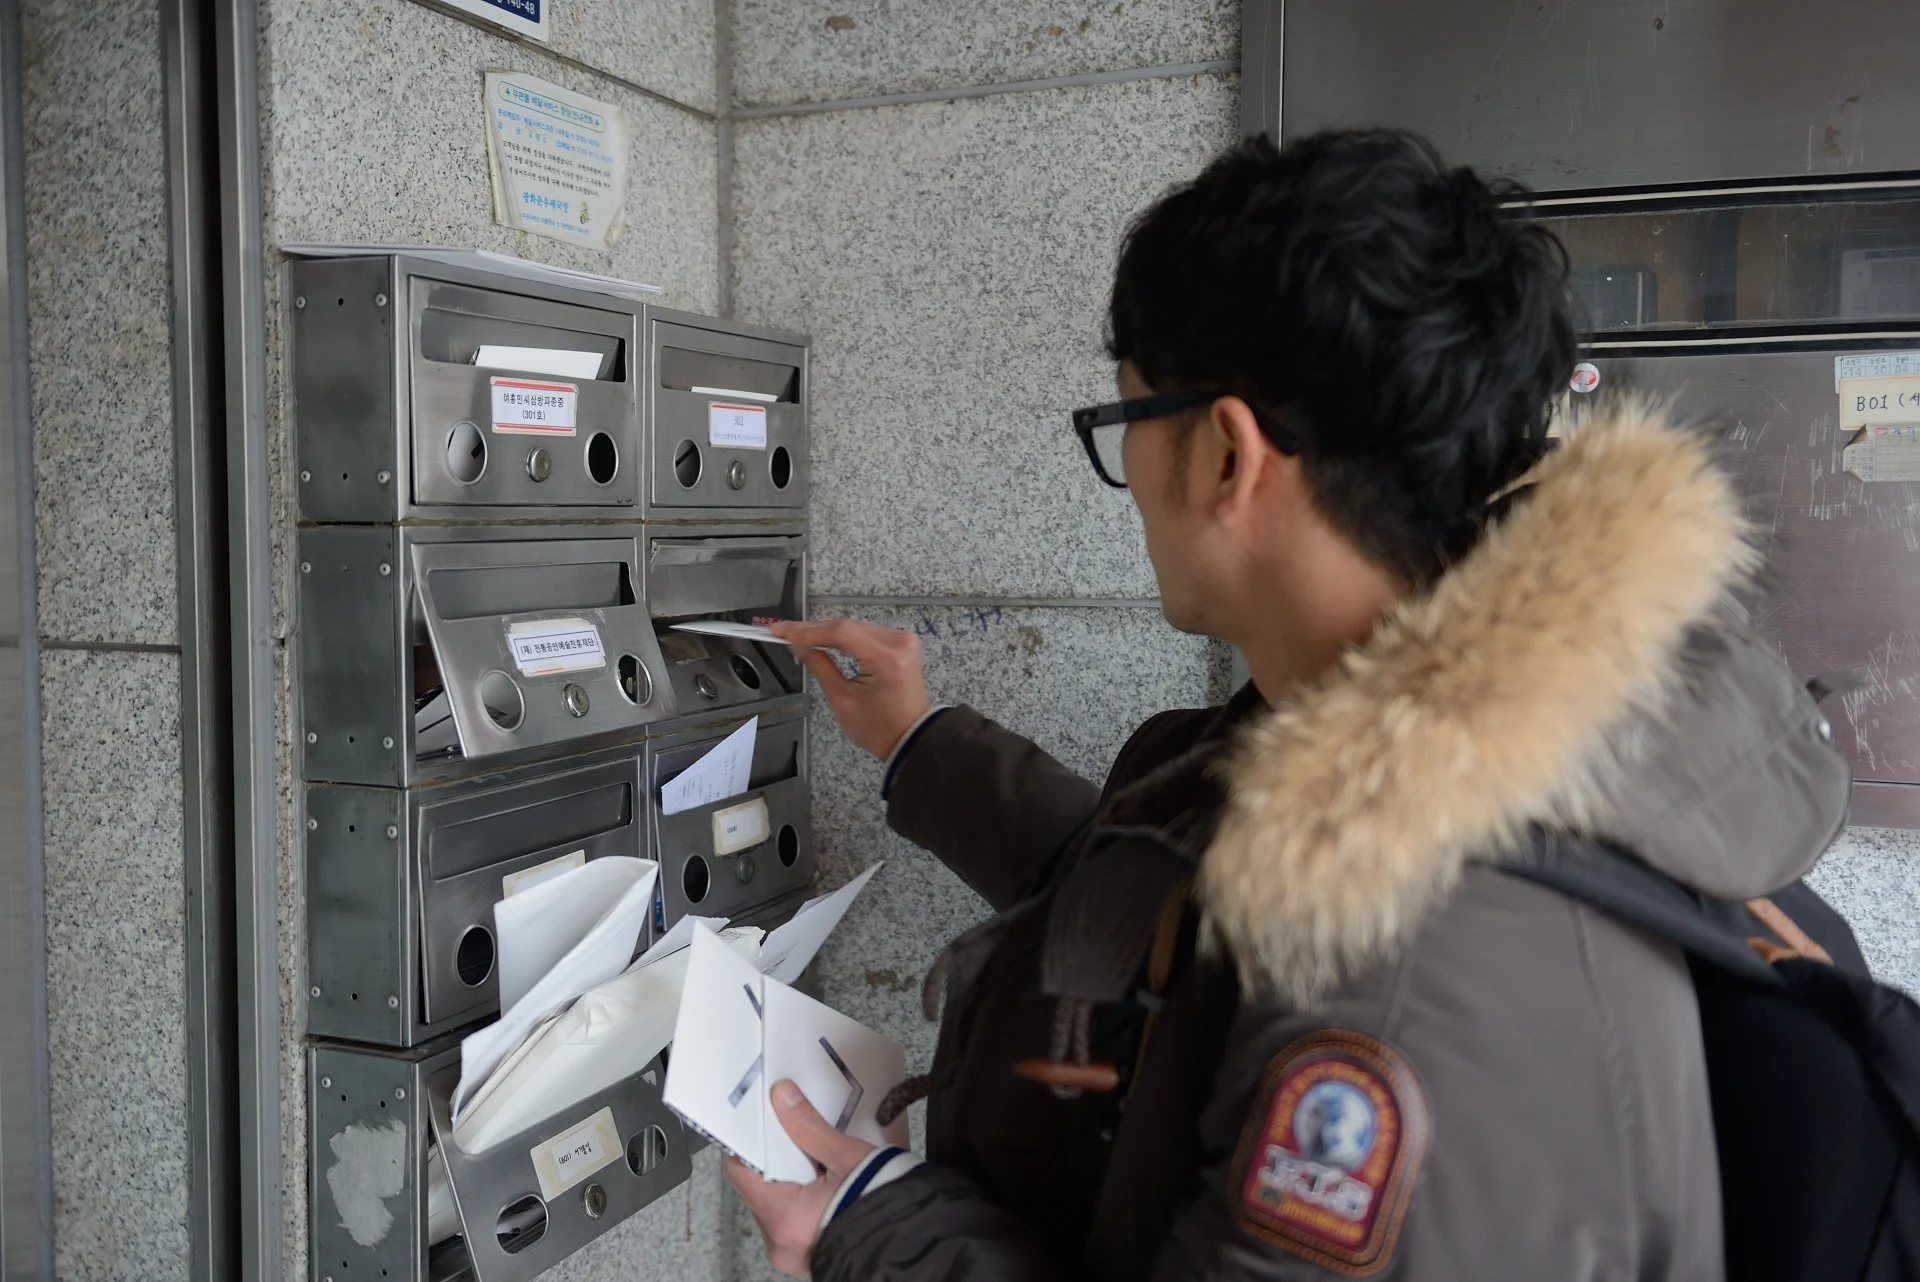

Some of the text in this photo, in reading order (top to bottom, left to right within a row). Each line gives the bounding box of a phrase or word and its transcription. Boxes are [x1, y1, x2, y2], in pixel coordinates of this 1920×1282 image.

[512, 89, 530, 104] 우편물
[532, 96, 558, 112] 배달서비스
[522, 191, 569, 214] 광화문우체국장
[503, 393, 564, 408] 여흥민씨삼방파종중
[522, 409, 546, 420] (301호)
[734, 415, 744, 426] 302
[520, 637, 595, 655] (재) 전통공연예술진흥재단
